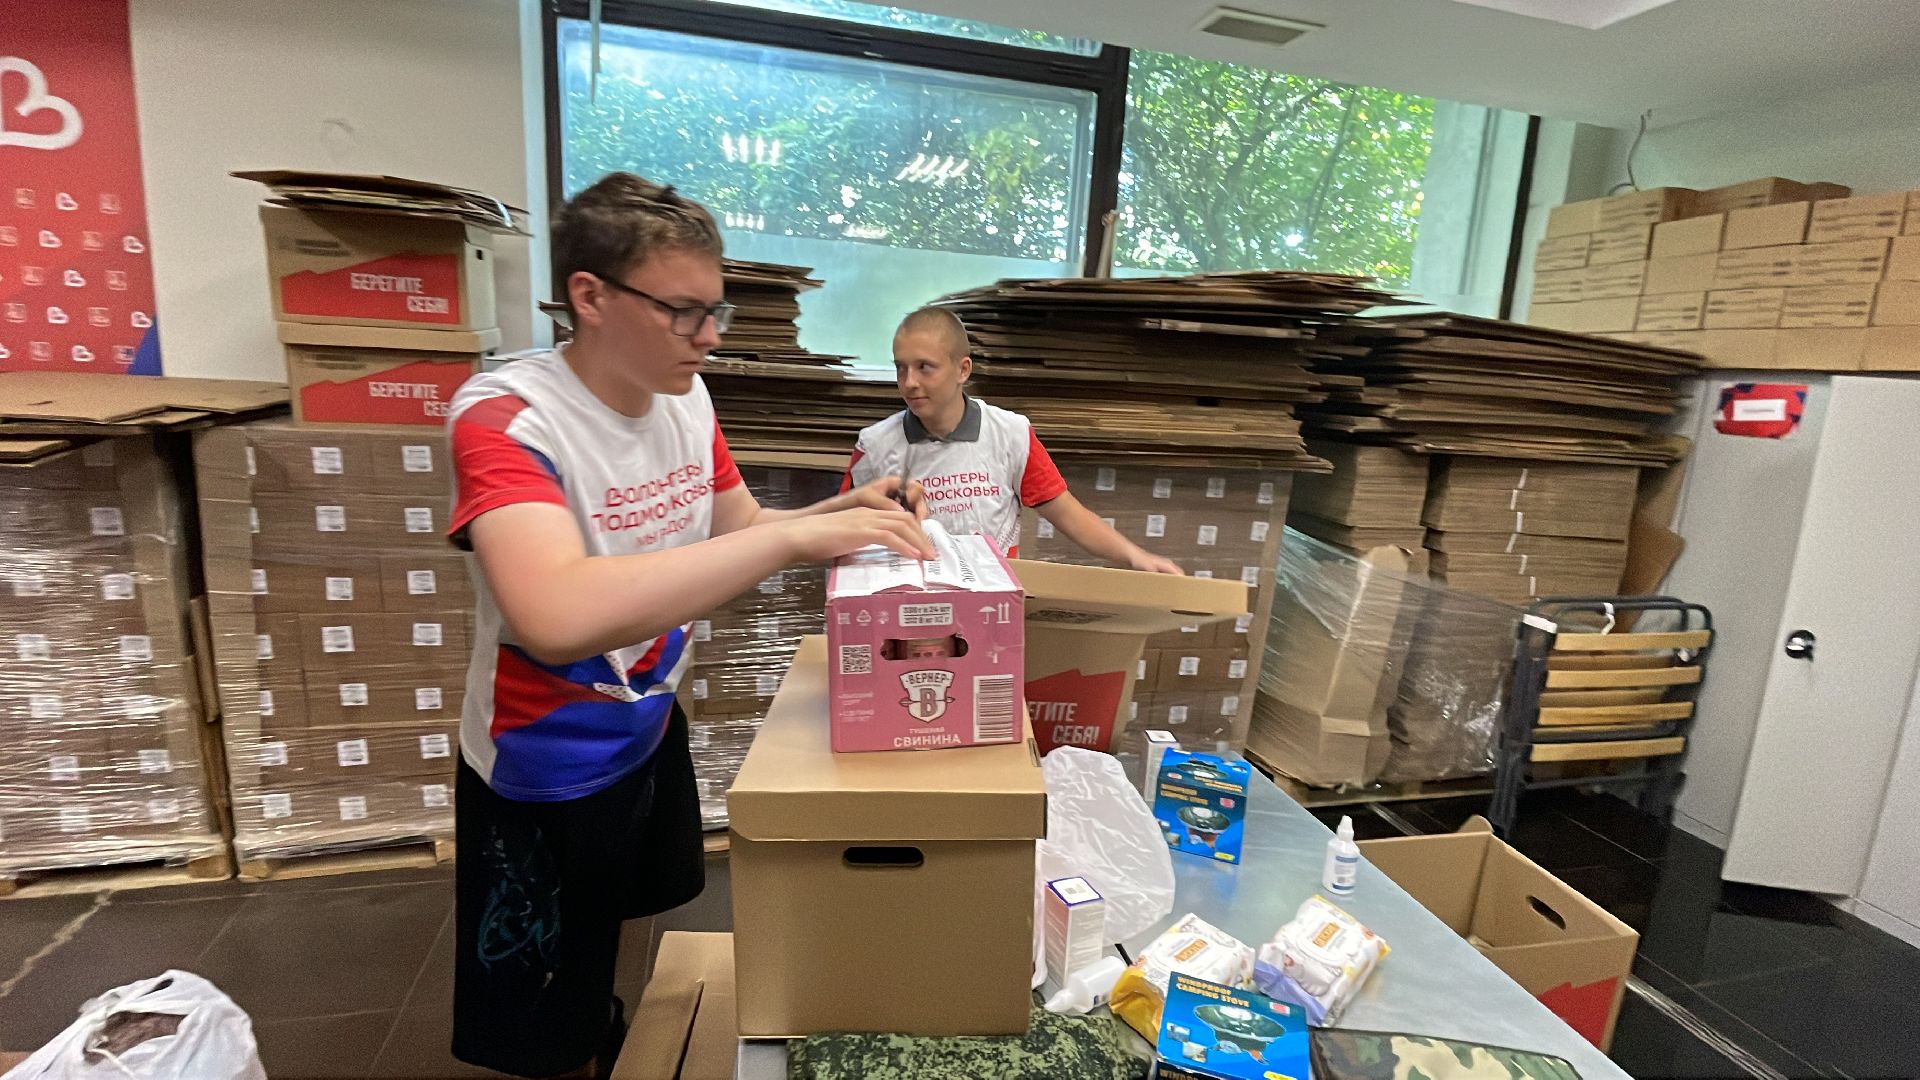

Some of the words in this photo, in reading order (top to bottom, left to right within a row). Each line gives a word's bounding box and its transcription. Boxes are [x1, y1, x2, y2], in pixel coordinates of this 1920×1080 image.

[351, 273, 424, 294] БЕРЕГИТЕ
[368, 382, 439, 399] БЕРЕГИТЕ
[917, 472, 990, 487] ЛОНТЕРЫ
[923, 486, 1000, 501] МОСКОВЬЯ
[939, 502, 974, 515] РЯДОМ
[907, 672, 948, 685] ВЕРНЕР
[1028, 701, 1078, 721] ЕГИТЕ
[894, 734, 961, 748] СВИНИНА
[1052, 725, 1099, 744] СЕБЯ!
[1221, 993, 1250, 1008] STOVE
